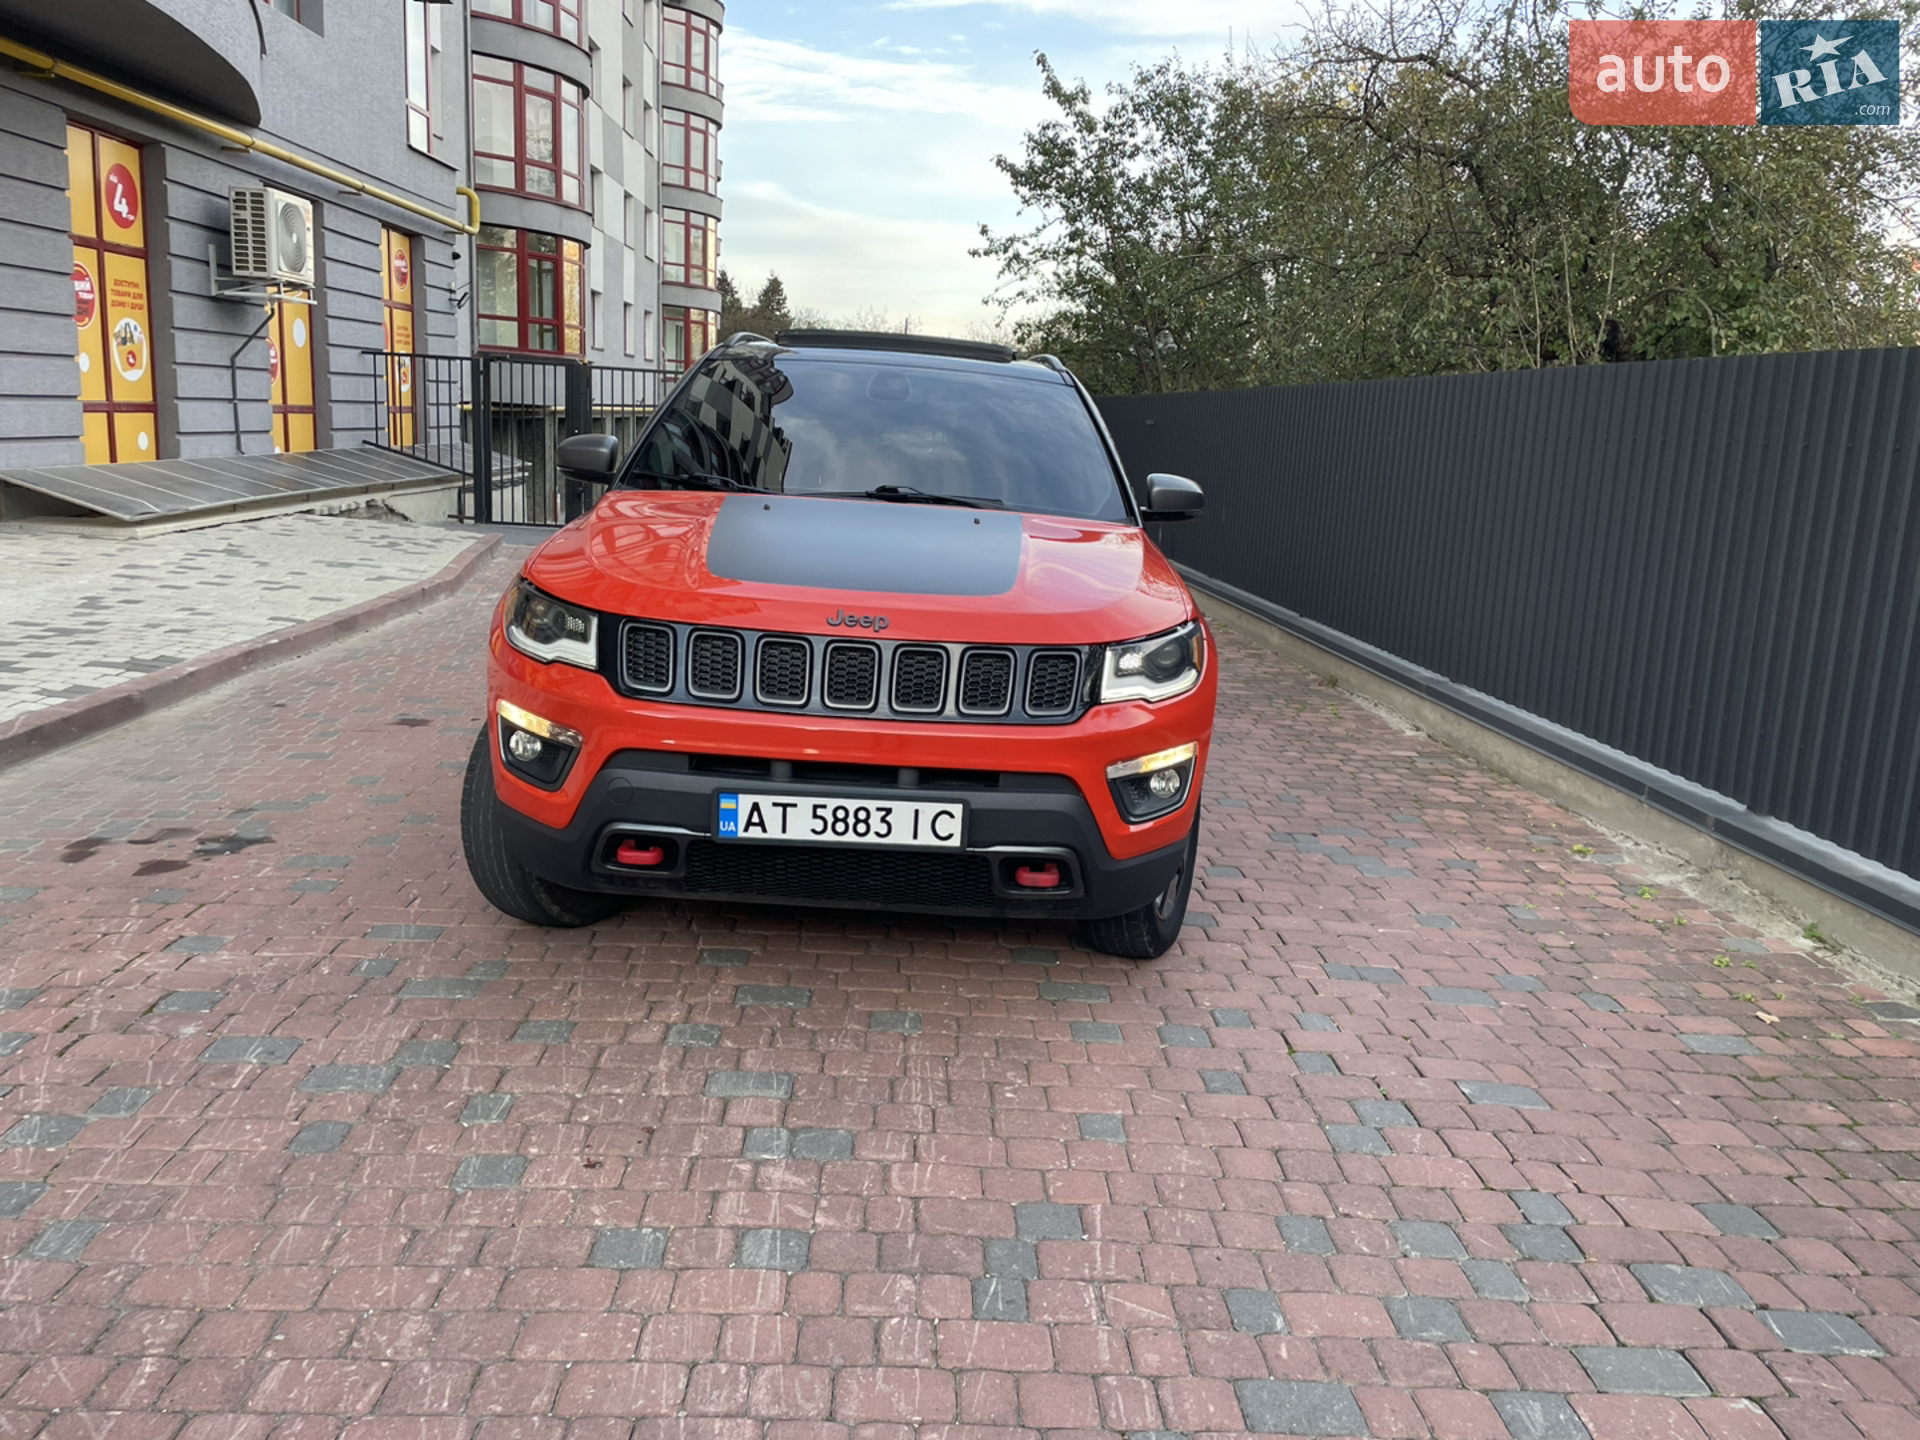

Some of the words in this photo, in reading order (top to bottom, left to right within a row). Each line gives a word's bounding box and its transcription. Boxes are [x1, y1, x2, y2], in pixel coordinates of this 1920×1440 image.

[826, 609, 890, 632] Jeep
[719, 820, 737, 832] UA
[743, 801, 797, 834] AT
[810, 804, 893, 838] 5883
[912, 808, 956, 841] IC
